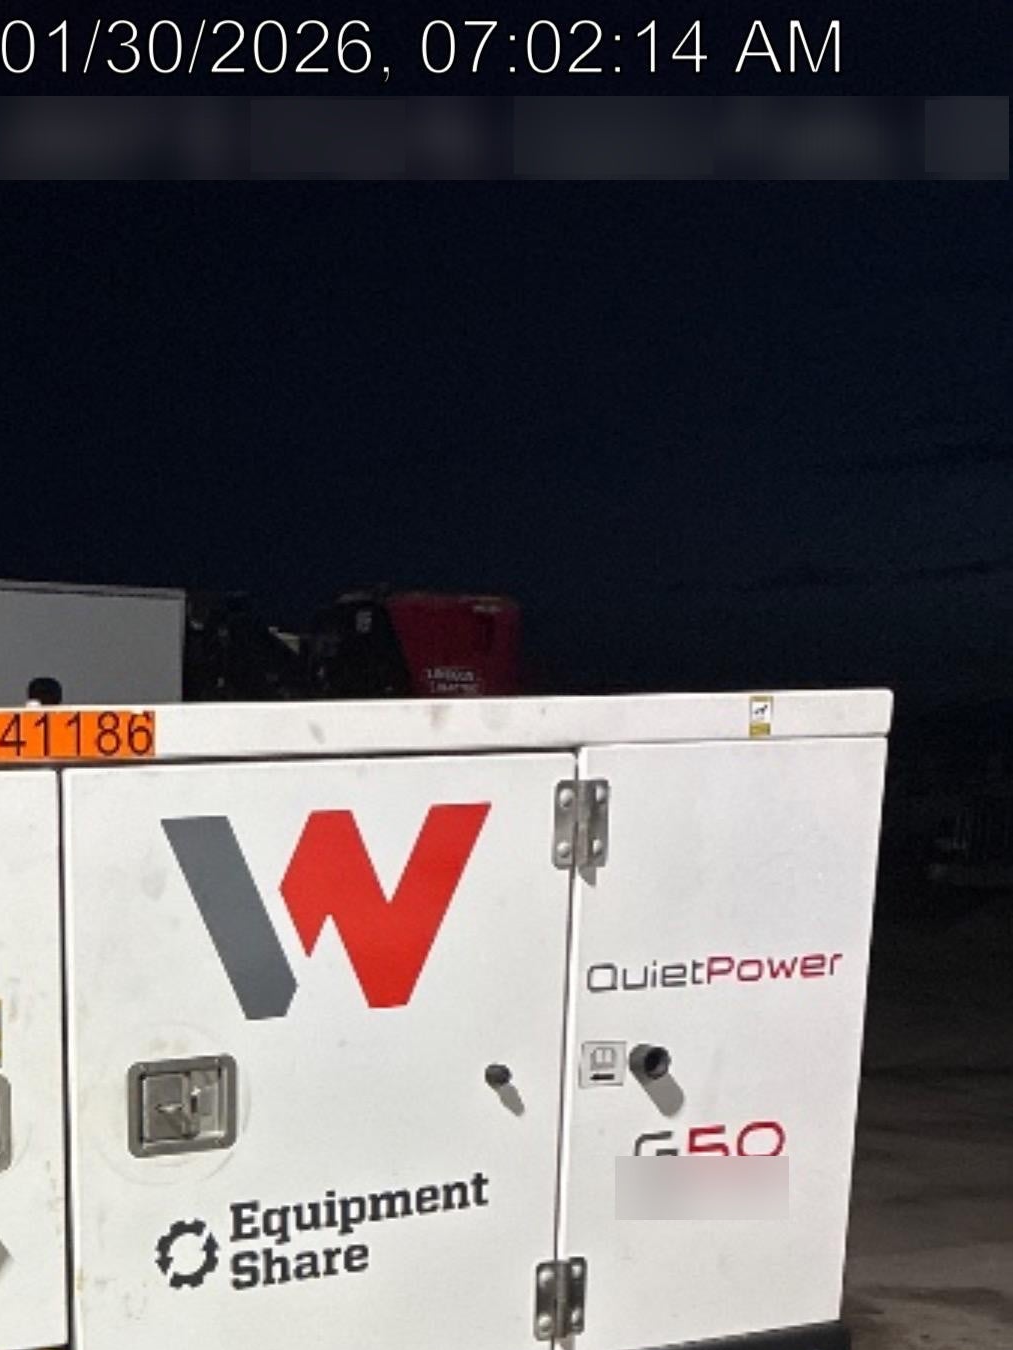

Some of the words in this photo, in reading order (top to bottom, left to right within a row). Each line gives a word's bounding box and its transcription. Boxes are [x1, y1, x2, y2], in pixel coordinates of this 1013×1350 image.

[587, 953, 843, 993] QuietPower
[229, 1172, 489, 1244] Equipment
[230, 1244, 369, 1289] Share
